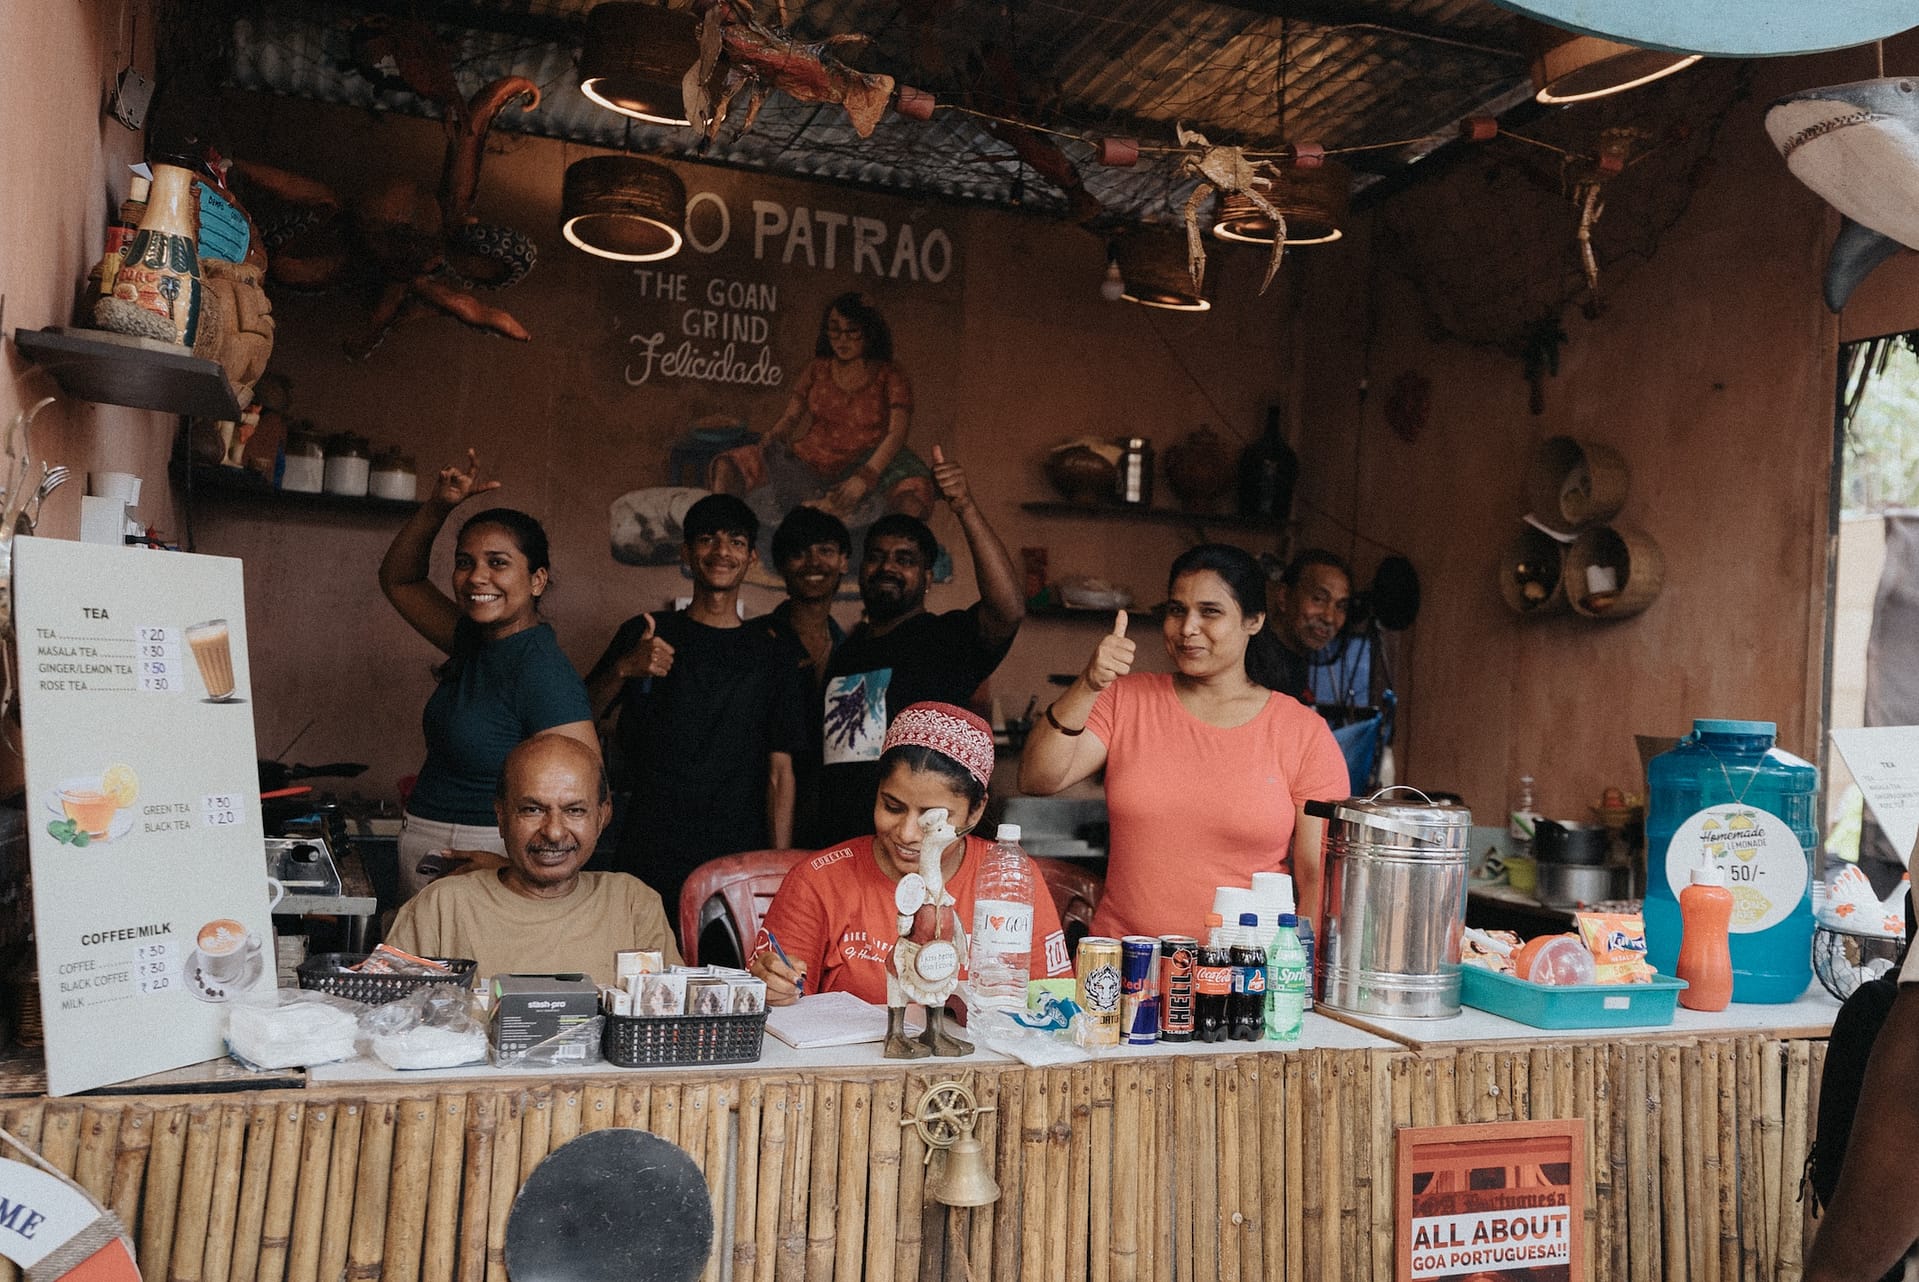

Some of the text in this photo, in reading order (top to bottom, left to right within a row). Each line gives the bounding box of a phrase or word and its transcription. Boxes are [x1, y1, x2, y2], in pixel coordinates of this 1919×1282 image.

[684, 191, 953, 283] O PATRAO
[632, 269, 777, 312] THE GOAN
[681, 308, 769, 344] GRIND
[624, 331, 783, 386] Felicidade
[83, 607, 109, 619] TEA
[36, 628, 57, 639] TEA
[37, 646, 77, 657] MASALA
[79, 647, 98, 657] TEA
[39, 663, 112, 674] GINGER/LEMON
[115, 664, 133, 675] TEA
[39, 680, 65, 691] ROSE
[68, 680, 88, 691] TEA
[143, 804, 172, 816] GREEN
[174, 803, 191, 813] TEA
[144, 821, 172, 833] BLACK
[174, 820, 191, 830] TEA
[1700, 826, 1766, 843] Homemade
[1726, 838, 1767, 850] LEMONADE
[81, 922, 172, 946] COFFEE/MILK
[58, 960, 97, 975] COFFEE
[60, 978, 92, 993] BLACK
[94, 972, 130, 987] COFFEE
[62, 997, 86, 1010] MILK
[1168, 972, 1193, 1025] HELL
[1413, 1213, 1568, 1251] ALL ABOUT
[1412, 1242, 1567, 1272] GOA PORTUGUESA!!
